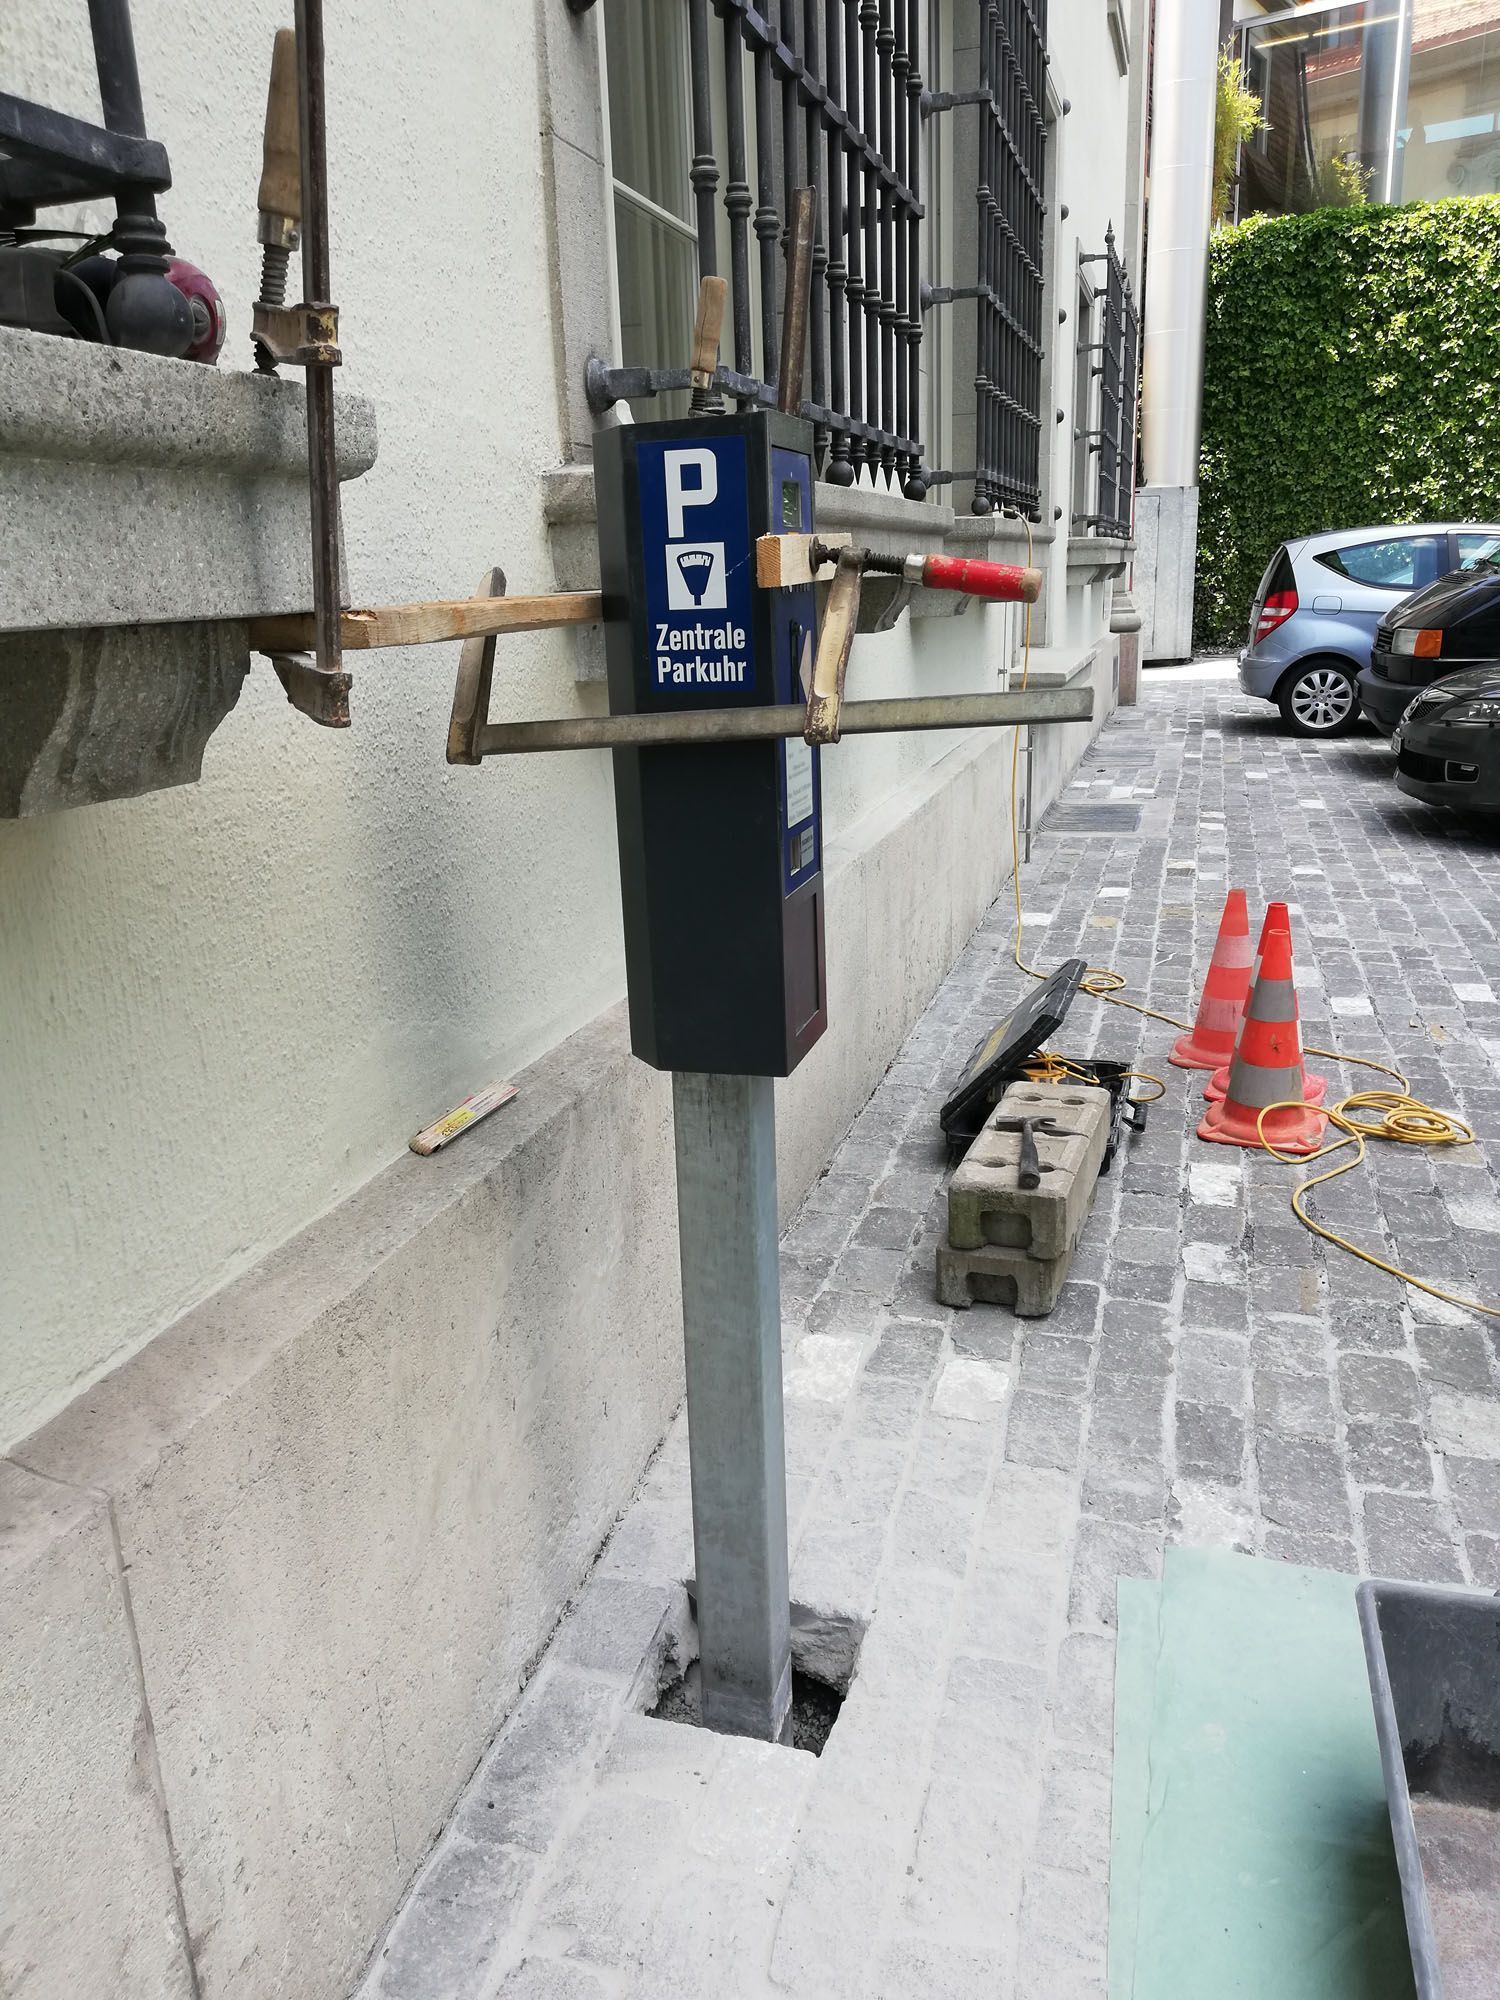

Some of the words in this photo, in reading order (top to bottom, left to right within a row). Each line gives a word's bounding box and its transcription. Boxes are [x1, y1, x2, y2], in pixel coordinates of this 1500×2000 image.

[664, 448, 718, 538] P
[655, 621, 746, 651] Zentrale
[657, 655, 747, 683] Parkuhr
